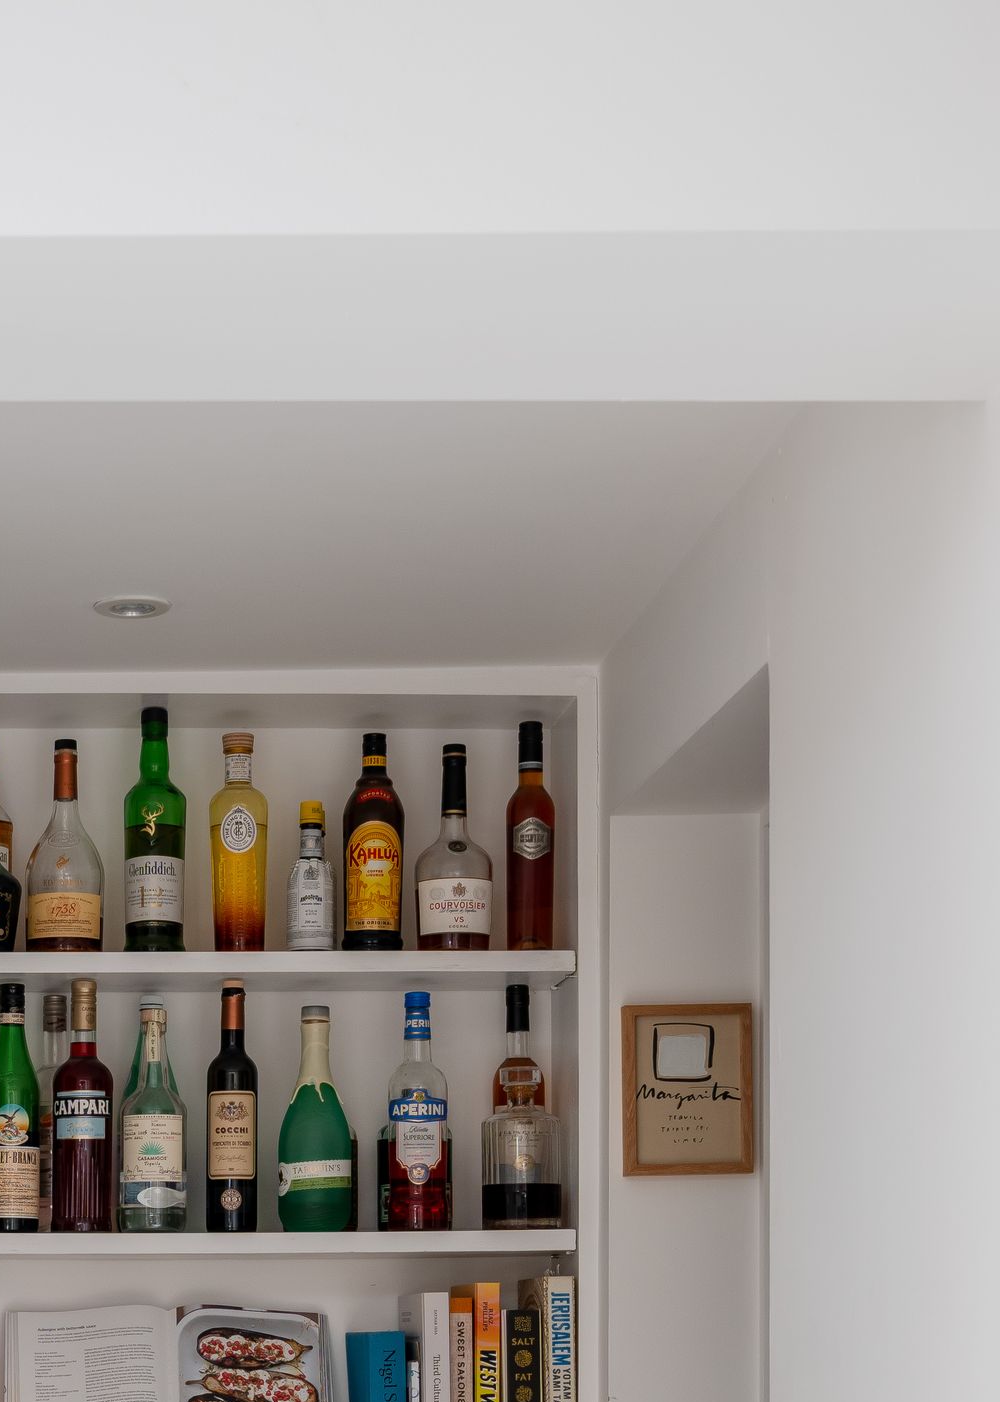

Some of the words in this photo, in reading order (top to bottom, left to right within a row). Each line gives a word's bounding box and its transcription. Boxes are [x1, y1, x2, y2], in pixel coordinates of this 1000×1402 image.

[228, 814, 242, 825] KING'S
[349, 842, 399, 868] KAHLÚA
[51, 902, 76, 917] 1738
[429, 901, 486, 911] COURVOISIER
[406, 1019, 430, 1028] PERI
[636, 1082, 741, 1110] Margarita
[54, 1100, 110, 1116] CAMPARI
[392, 1103, 444, 1116] APERINI
[215, 1126, 249, 1134] COCCHI
[551, 1292, 571, 1366] JERUSALEM
[457, 1321, 465, 1359] SWEET
[511, 1337, 535, 1346] SALT
[378, 1350, 397, 1388] Nigel
[433, 1354, 441, 1377] Third
[480, 1350, 497, 1392] WEST
[515, 1372, 533, 1381] FAT
[552, 1369, 561, 1392] SAMI
[562, 1368, 572, 1398] YOTAM
